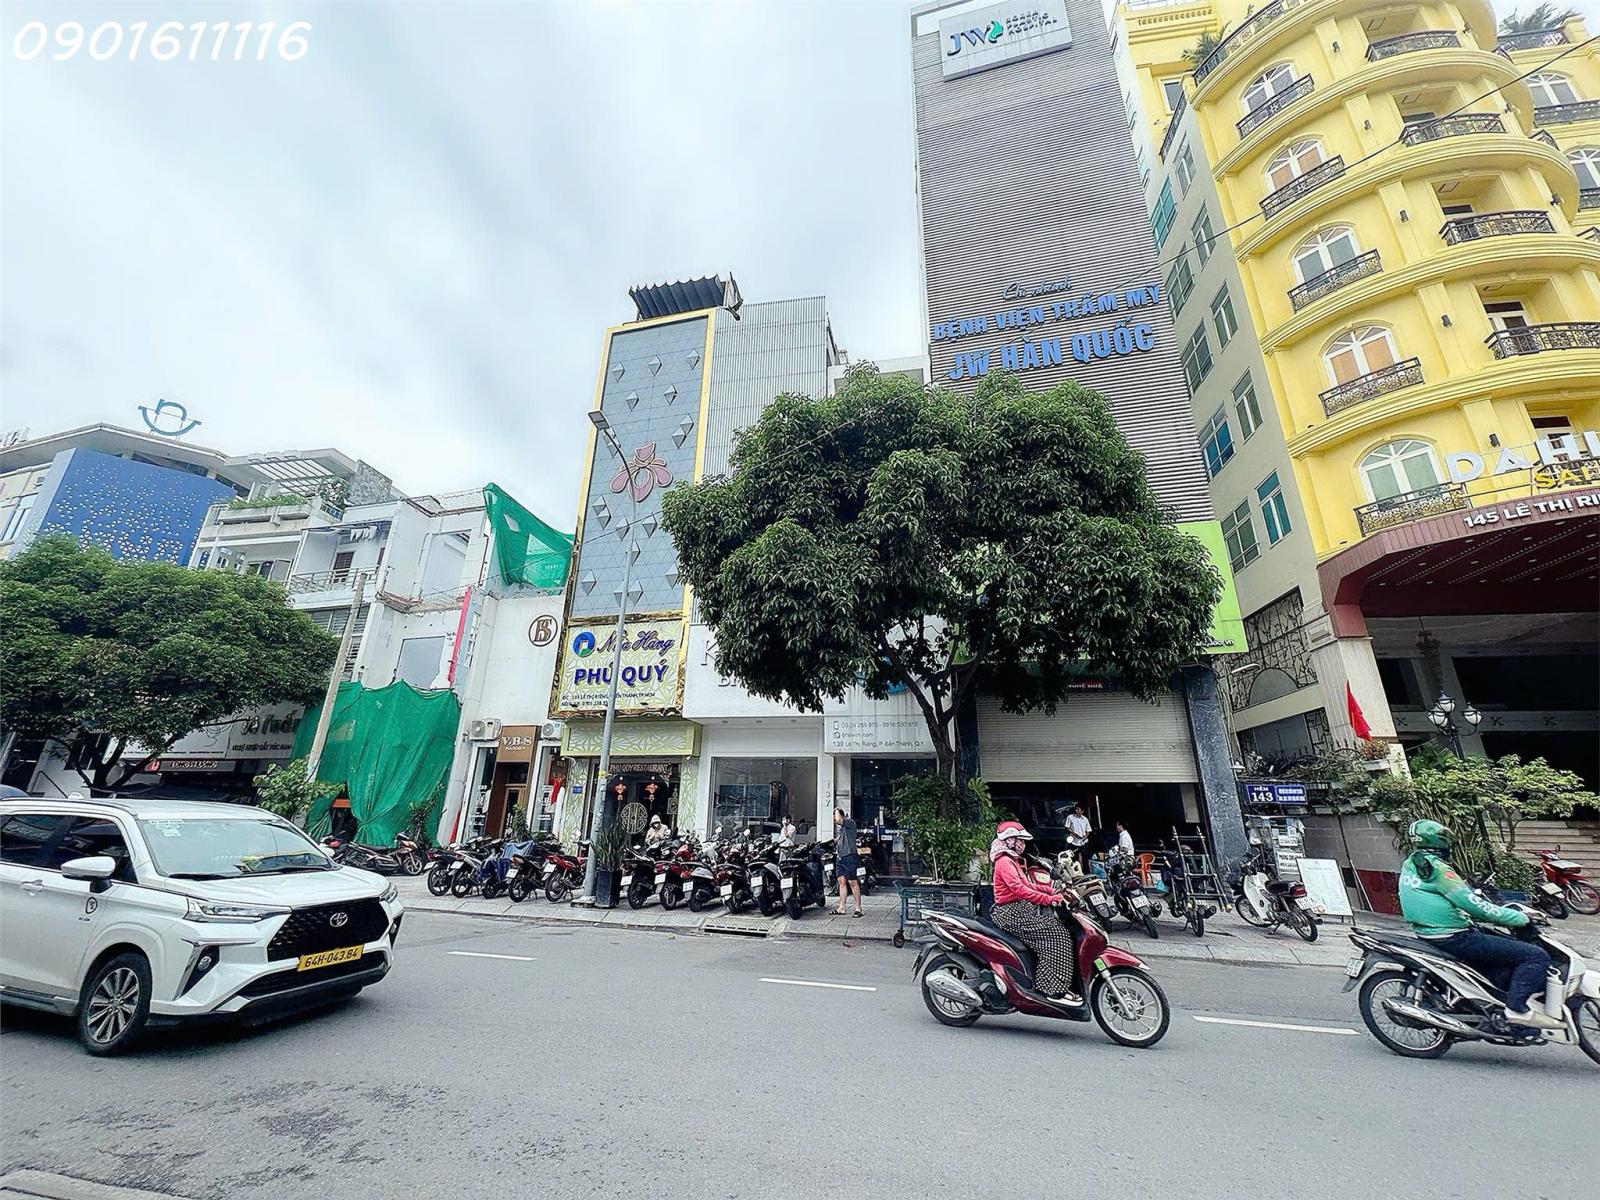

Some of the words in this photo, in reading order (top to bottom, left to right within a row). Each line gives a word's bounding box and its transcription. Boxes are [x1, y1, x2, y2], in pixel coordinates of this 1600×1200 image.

[946, 24, 991, 56] JW
[933, 317, 988, 343] BỆNH
[995, 306, 1045, 331] VIỆN
[948, 347, 993, 381] JW
[1000, 335, 1064, 372] HÀN
[1071, 316, 1155, 364] QUỐC
[1464, 511, 1499, 528] 145
[1503, 502, 1531, 520] LÊ
[1534, 497, 1573, 513] THỊ
[621, 659, 669, 687] QUÝ
[1251, 791, 1274, 802] 143
[305, 948, 359, 967] 64H-043.84
